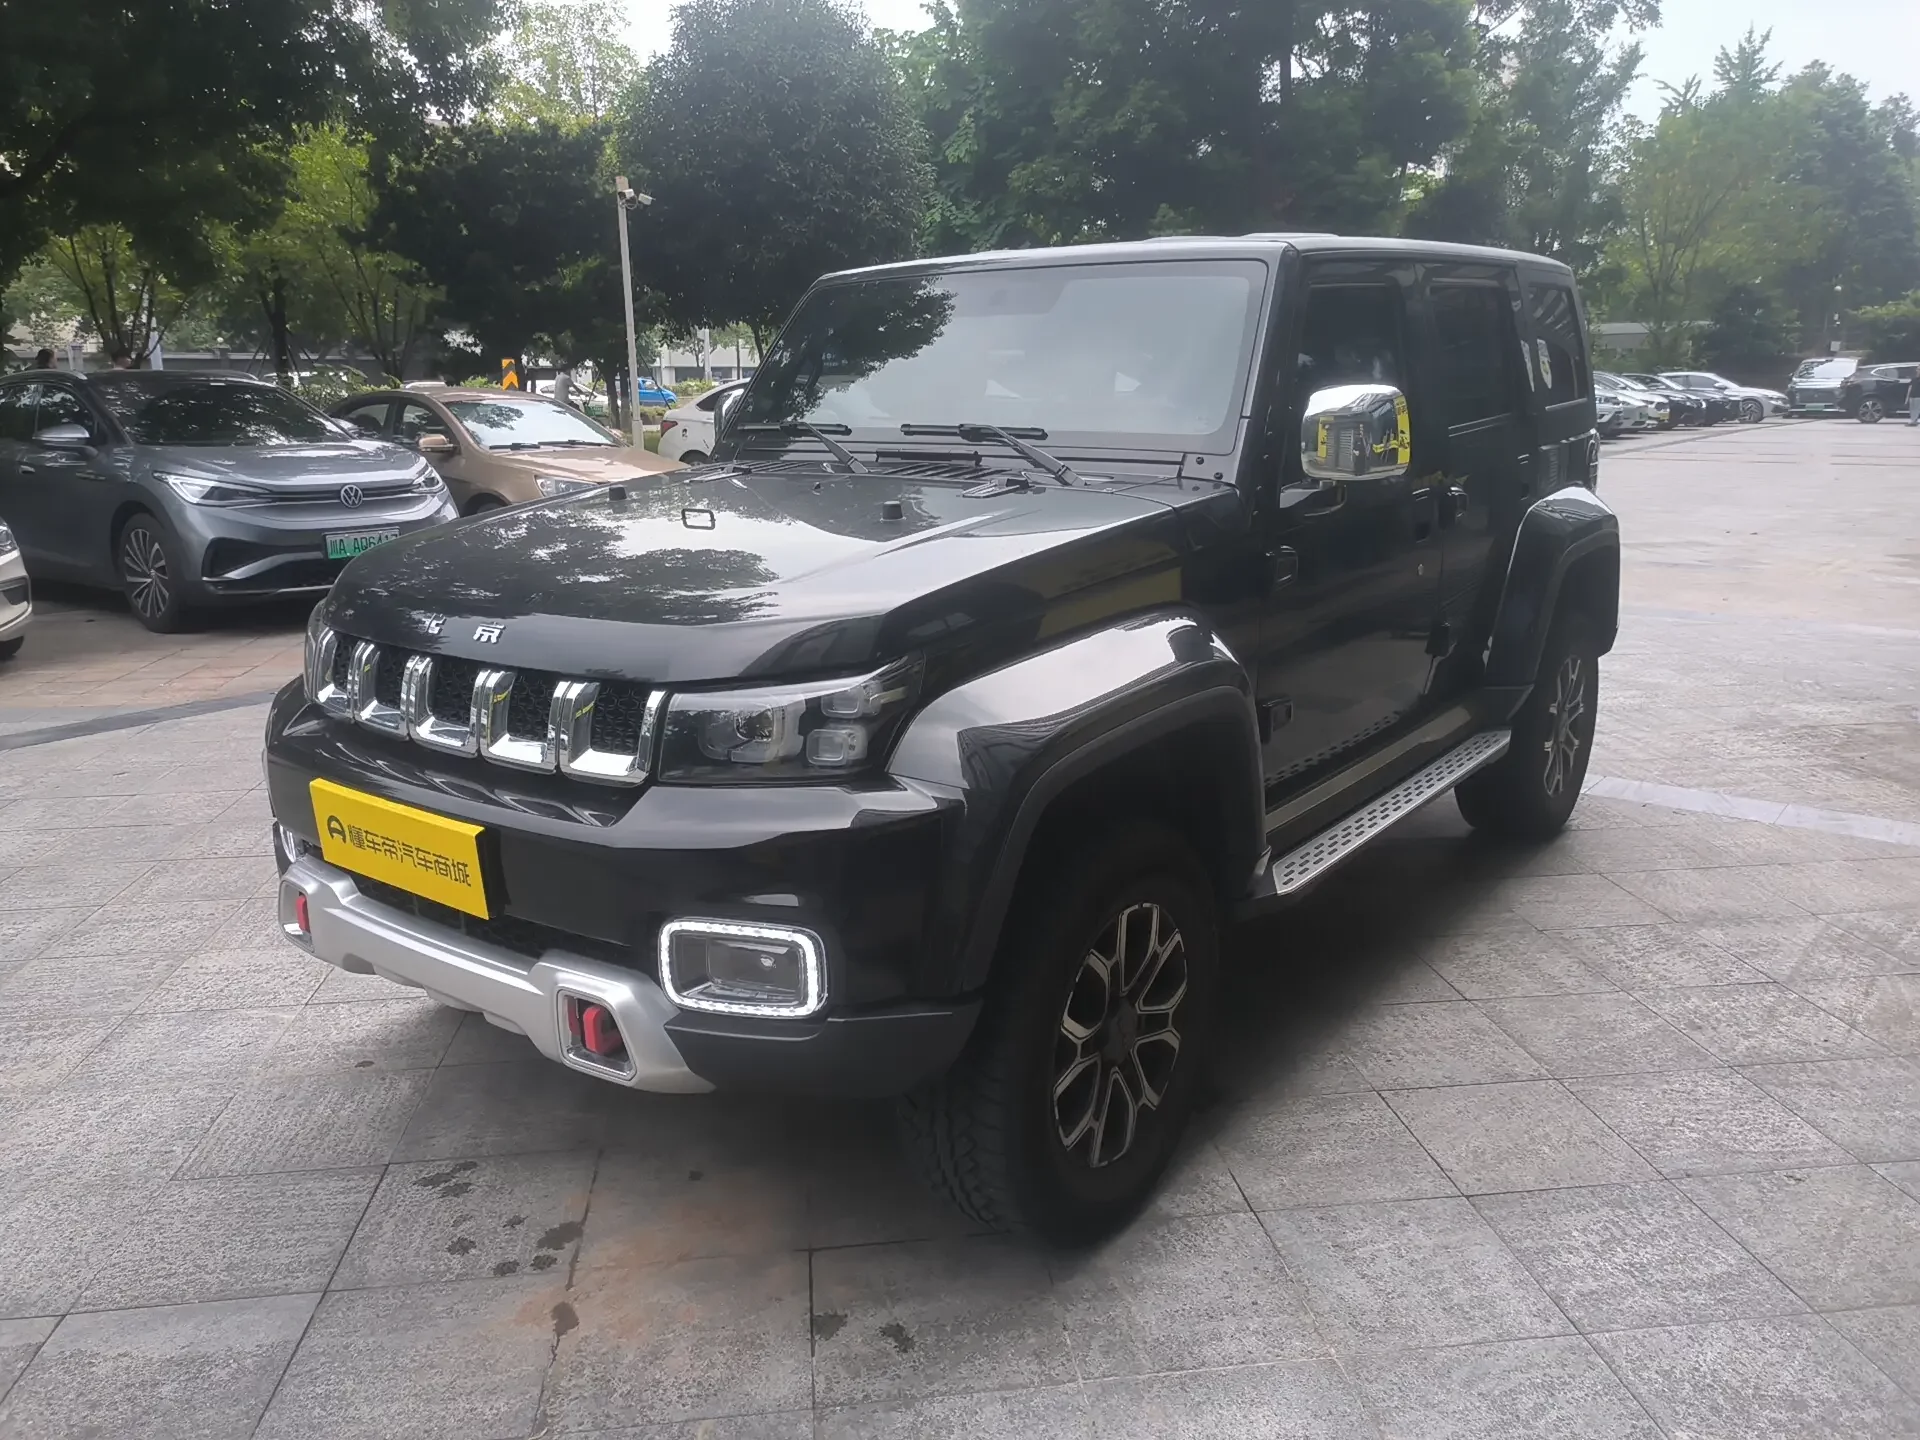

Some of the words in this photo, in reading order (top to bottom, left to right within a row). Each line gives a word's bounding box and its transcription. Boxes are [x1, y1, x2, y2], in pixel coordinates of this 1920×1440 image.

[347, 824, 472, 887] 懂车帝汽车商城
